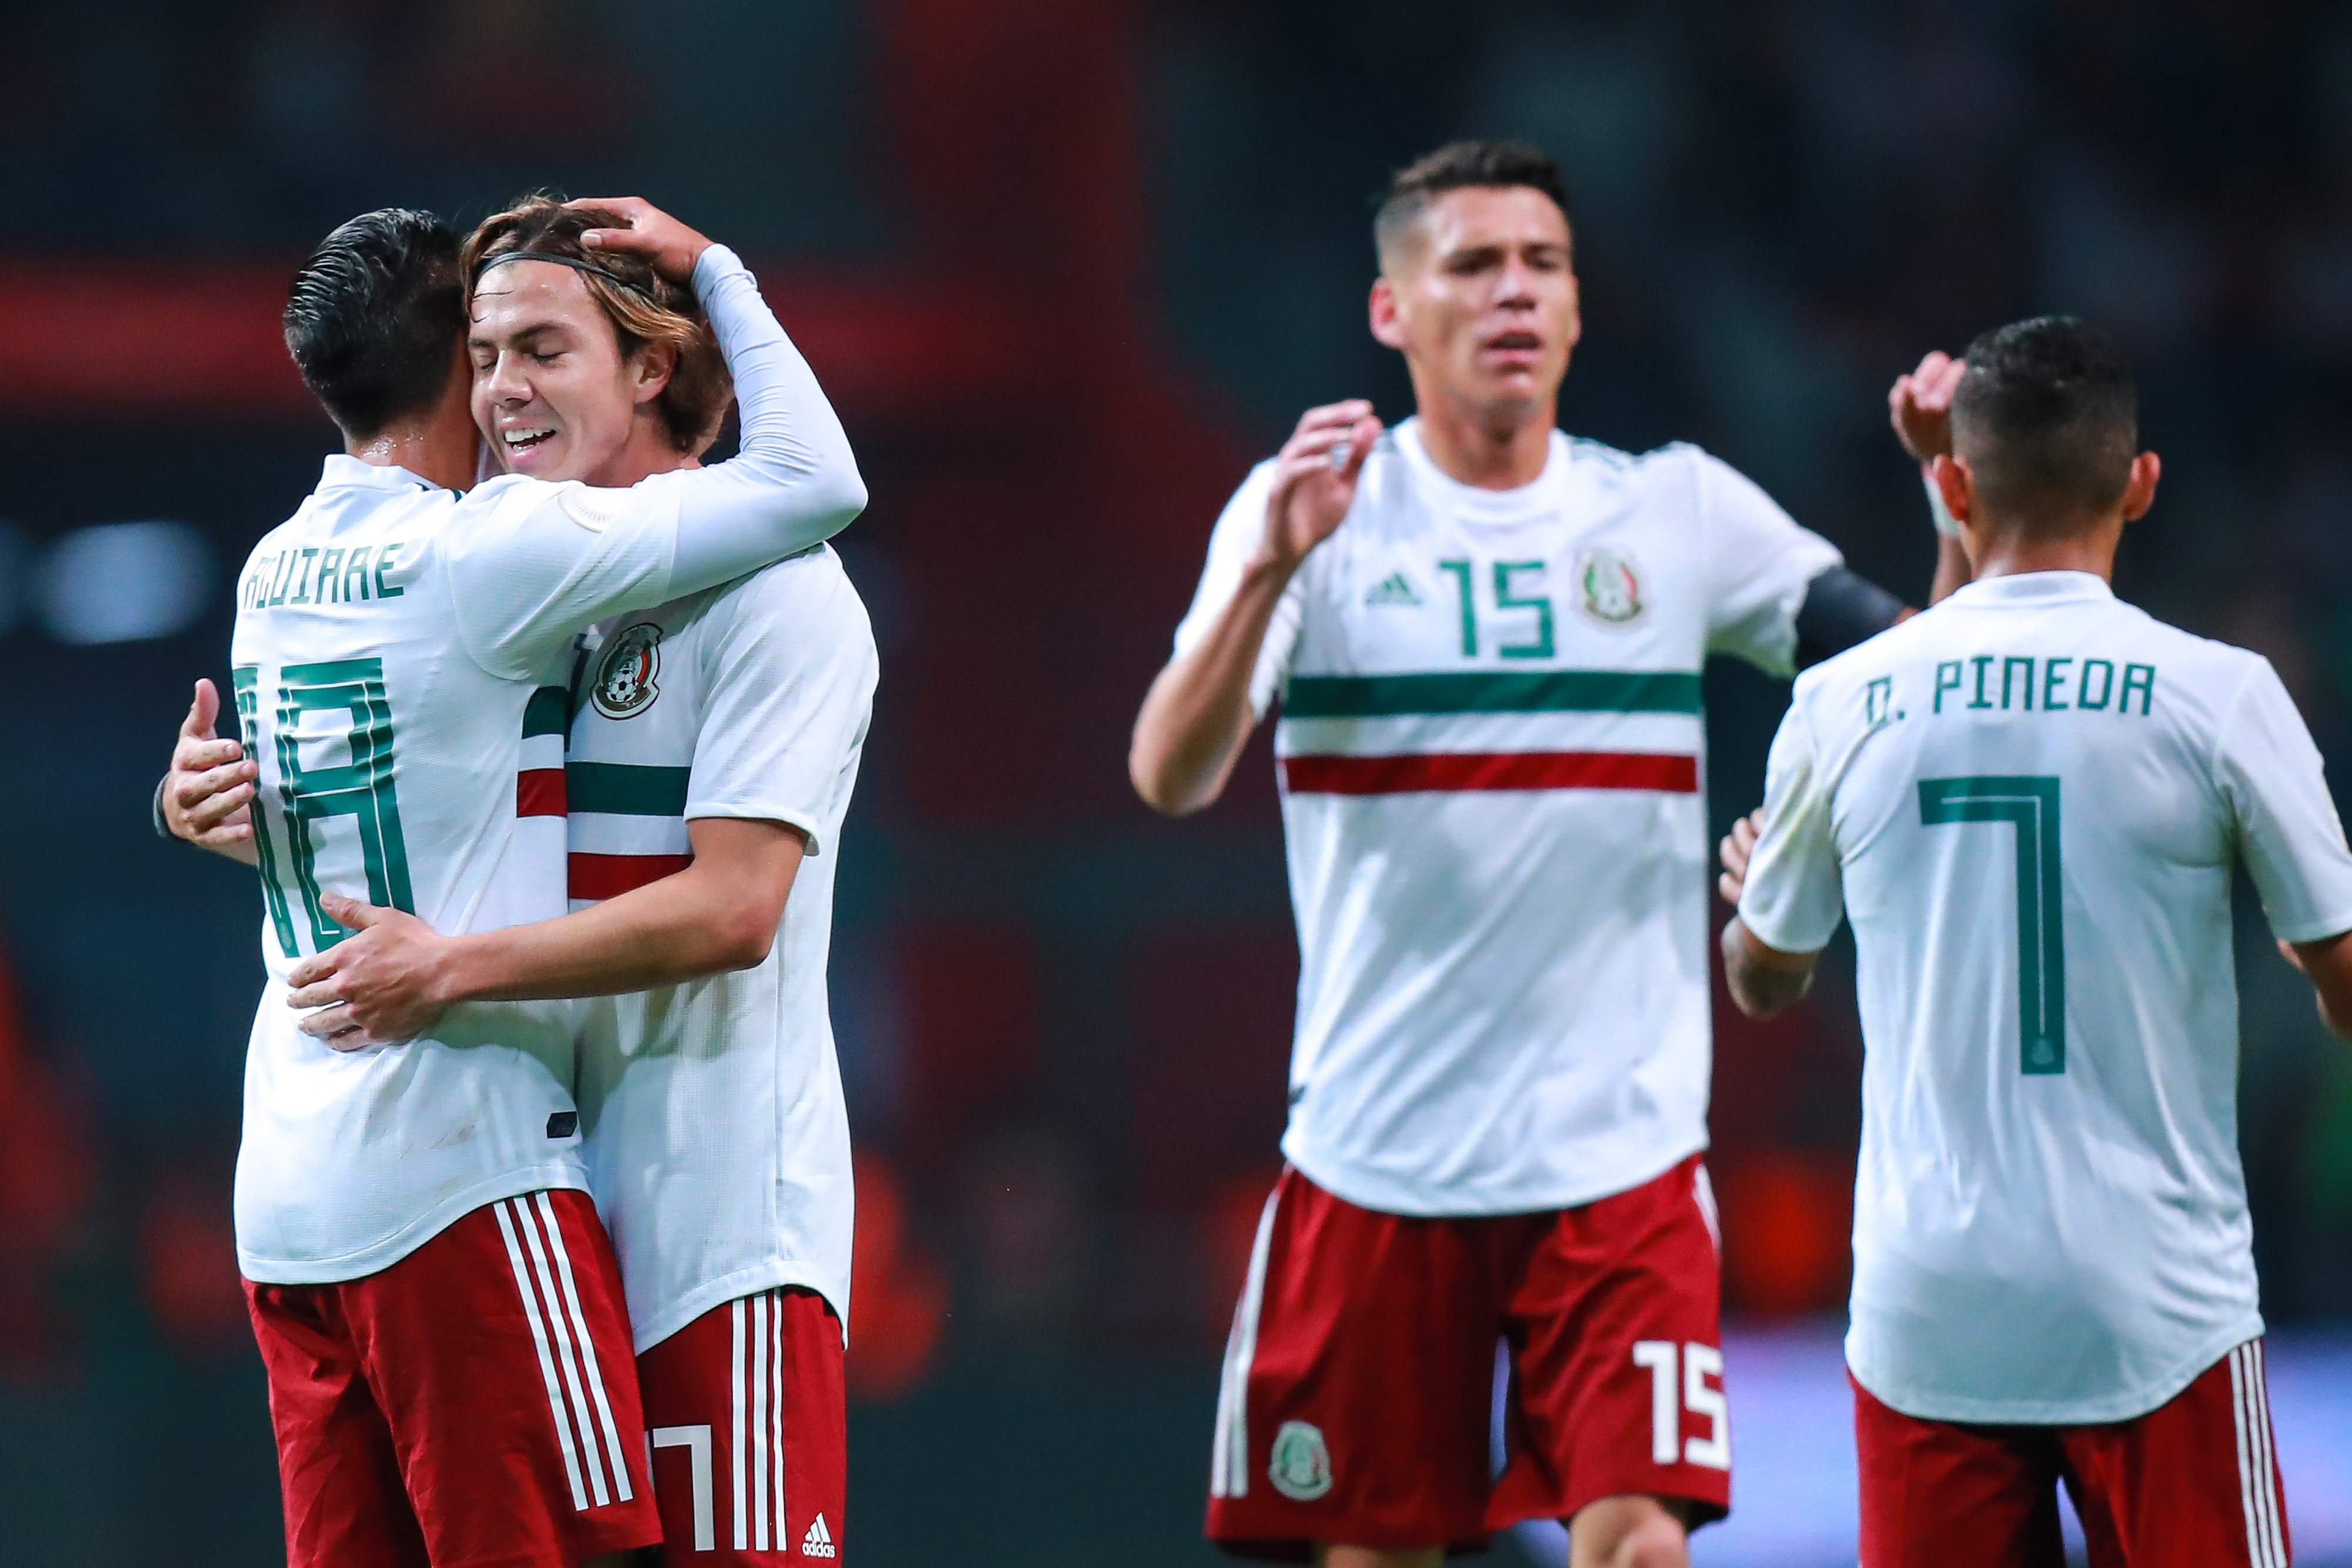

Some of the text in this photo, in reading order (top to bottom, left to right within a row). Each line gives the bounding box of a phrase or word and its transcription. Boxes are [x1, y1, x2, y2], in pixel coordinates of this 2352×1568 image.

[243, 542, 405, 610] AGUIRRE
[1436, 559, 1555, 658] 15
[1932, 655, 2156, 716] PINEDA
[233, 657, 416, 958] 18
[1917, 775, 2065, 1074] 7
[1632, 1340, 1731, 1471] 15
[802, 1541, 836, 1559] adidas
